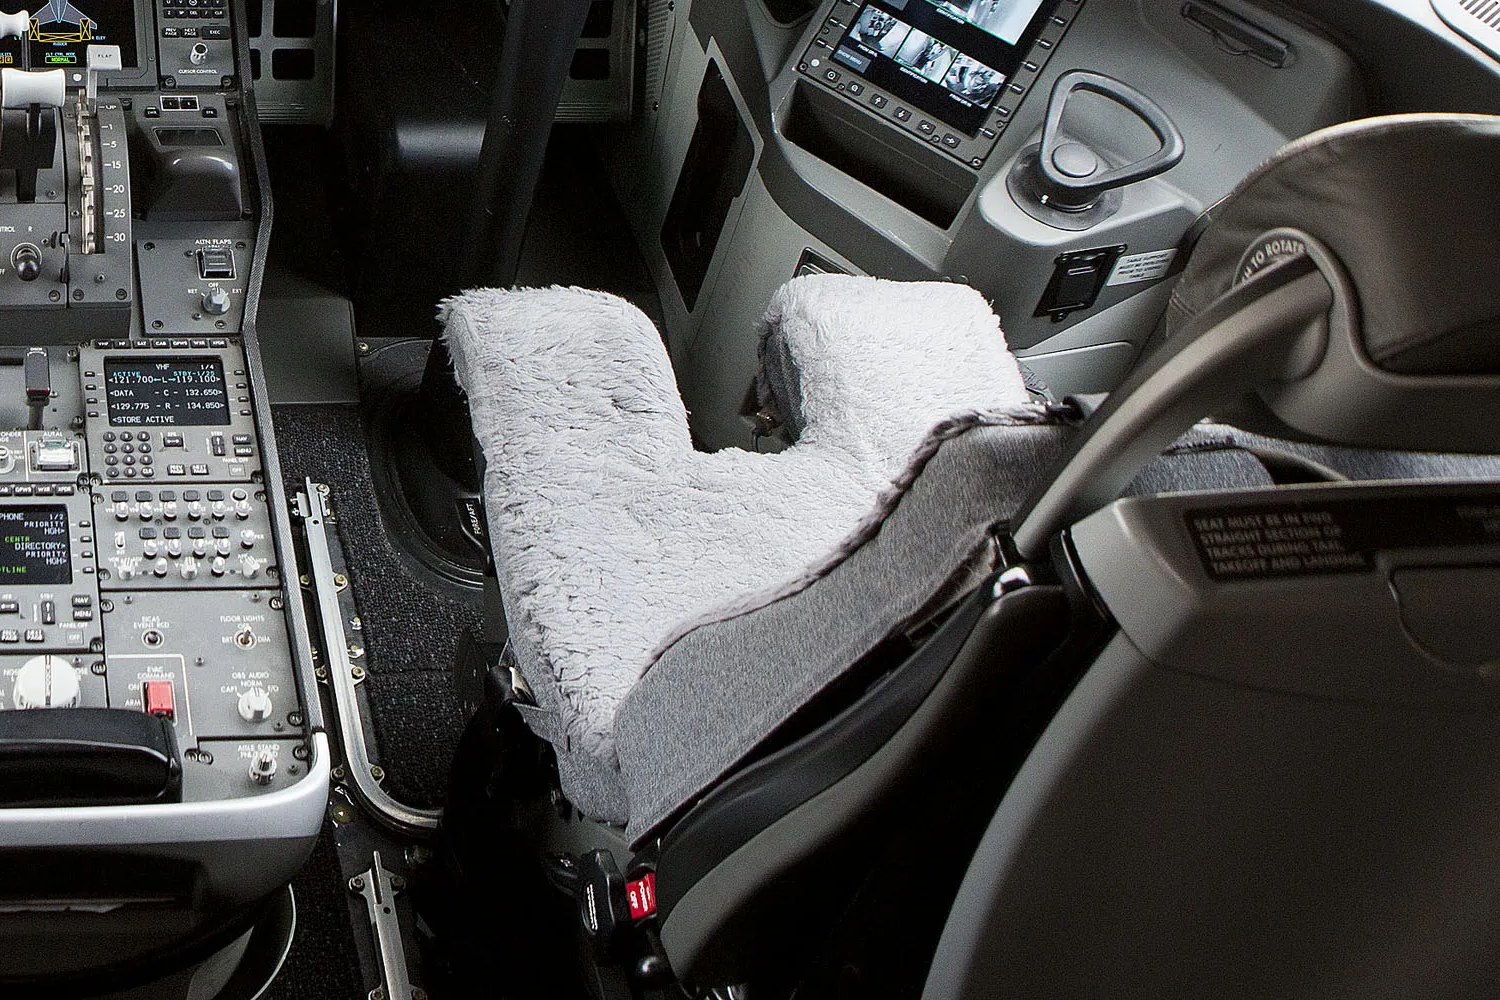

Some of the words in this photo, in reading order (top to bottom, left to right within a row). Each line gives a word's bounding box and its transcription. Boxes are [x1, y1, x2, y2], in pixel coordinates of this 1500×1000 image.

[111, 161, 121, 169] 15
[112, 185, 125, 193] 20
[113, 209, 126, 217] 25
[113, 233, 126, 241] 30
[1251, 251, 1265, 269] TO
[220, 615, 242, 623] FLOOR
[248, 671, 270, 679] AUDIO
[124, 699, 141, 707] ARM
